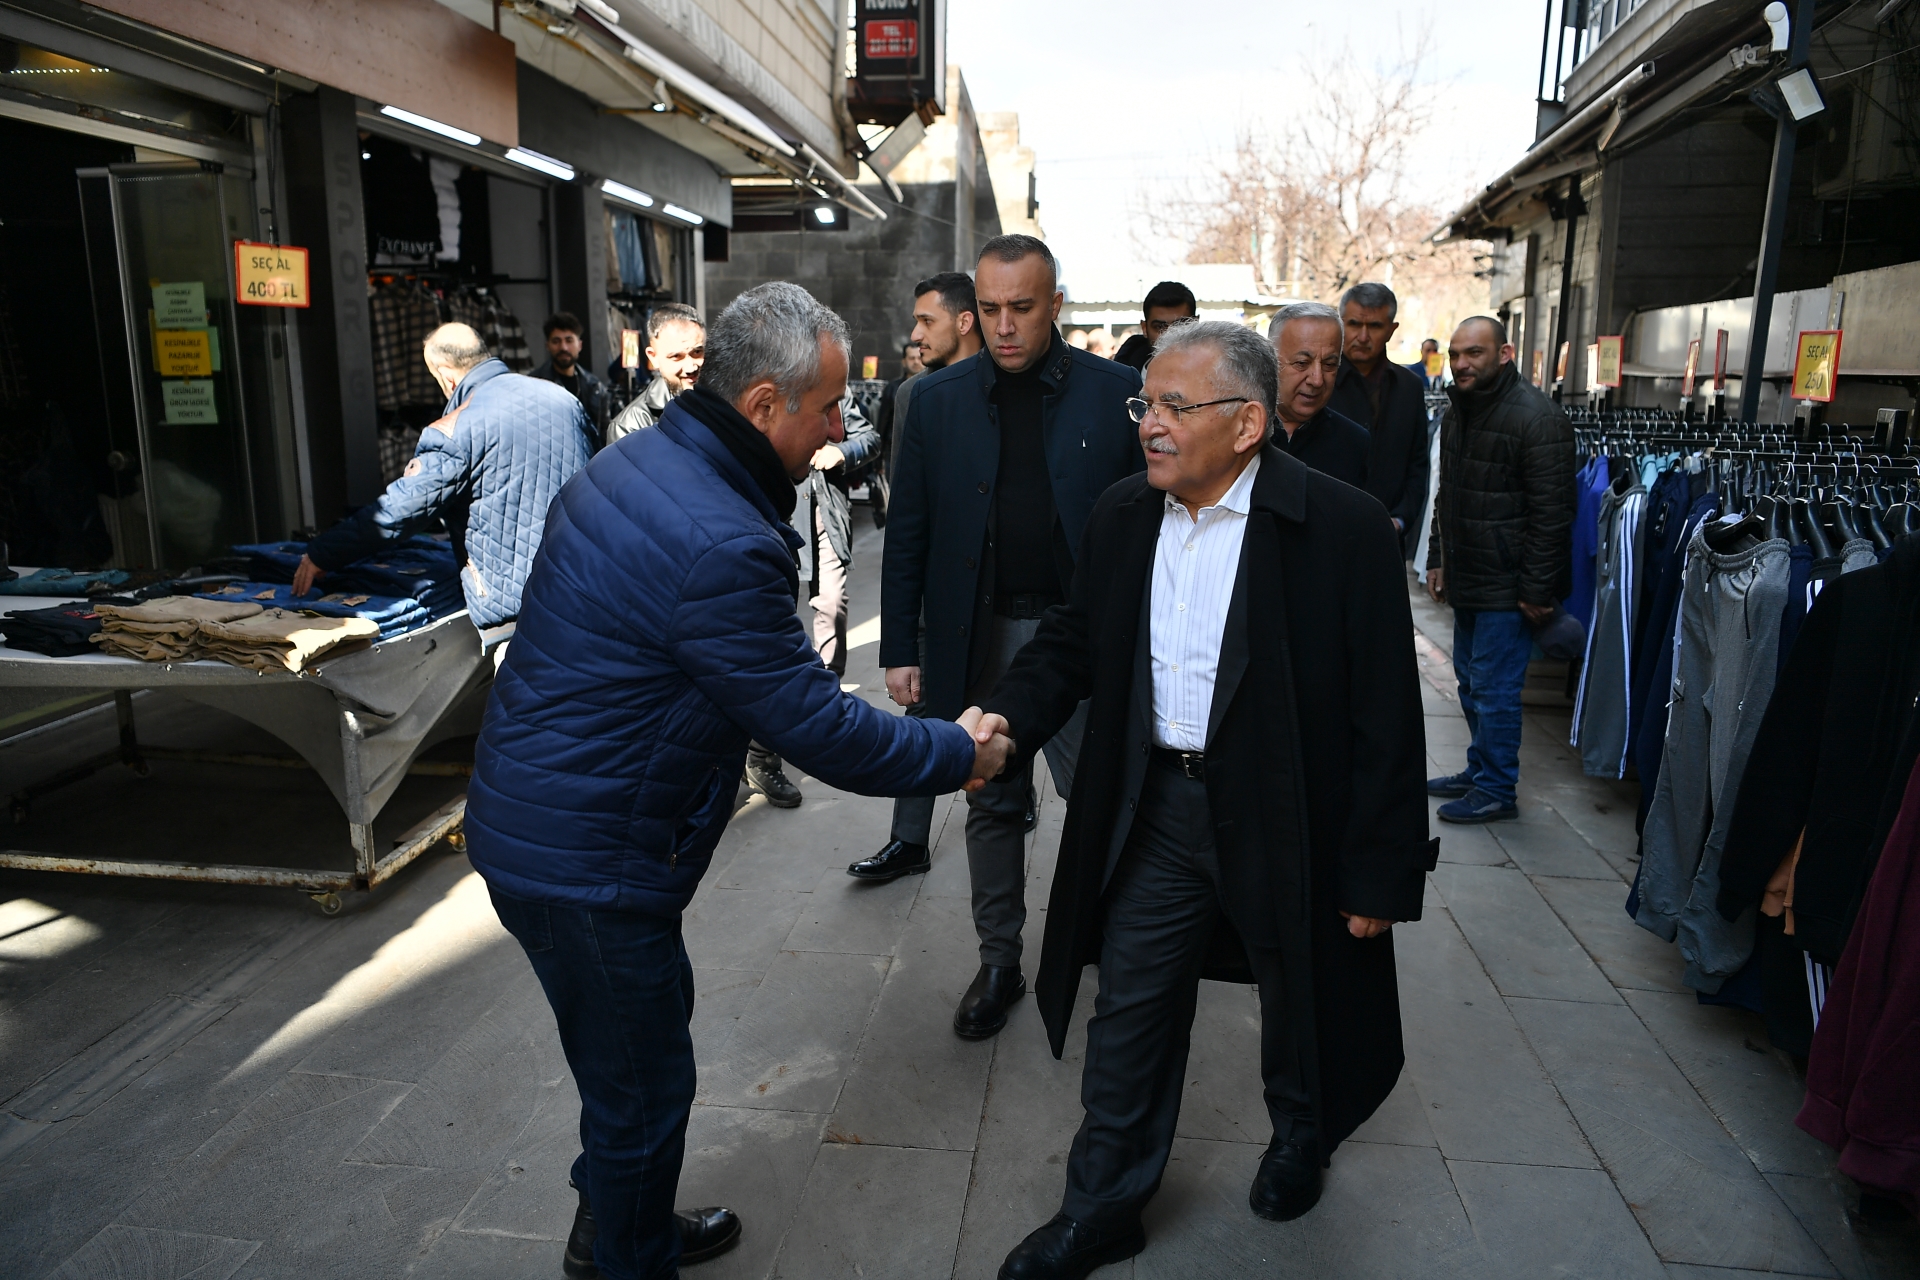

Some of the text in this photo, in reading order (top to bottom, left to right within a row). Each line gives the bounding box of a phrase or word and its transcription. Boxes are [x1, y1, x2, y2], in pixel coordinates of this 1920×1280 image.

[882, 25, 902, 37] TEL
[251, 256, 291, 272] SEÇ AL
[247, 281, 298, 298] 400 TL
[1806, 345, 1821, 360] SEÇ
[1804, 371, 1824, 390] 250
